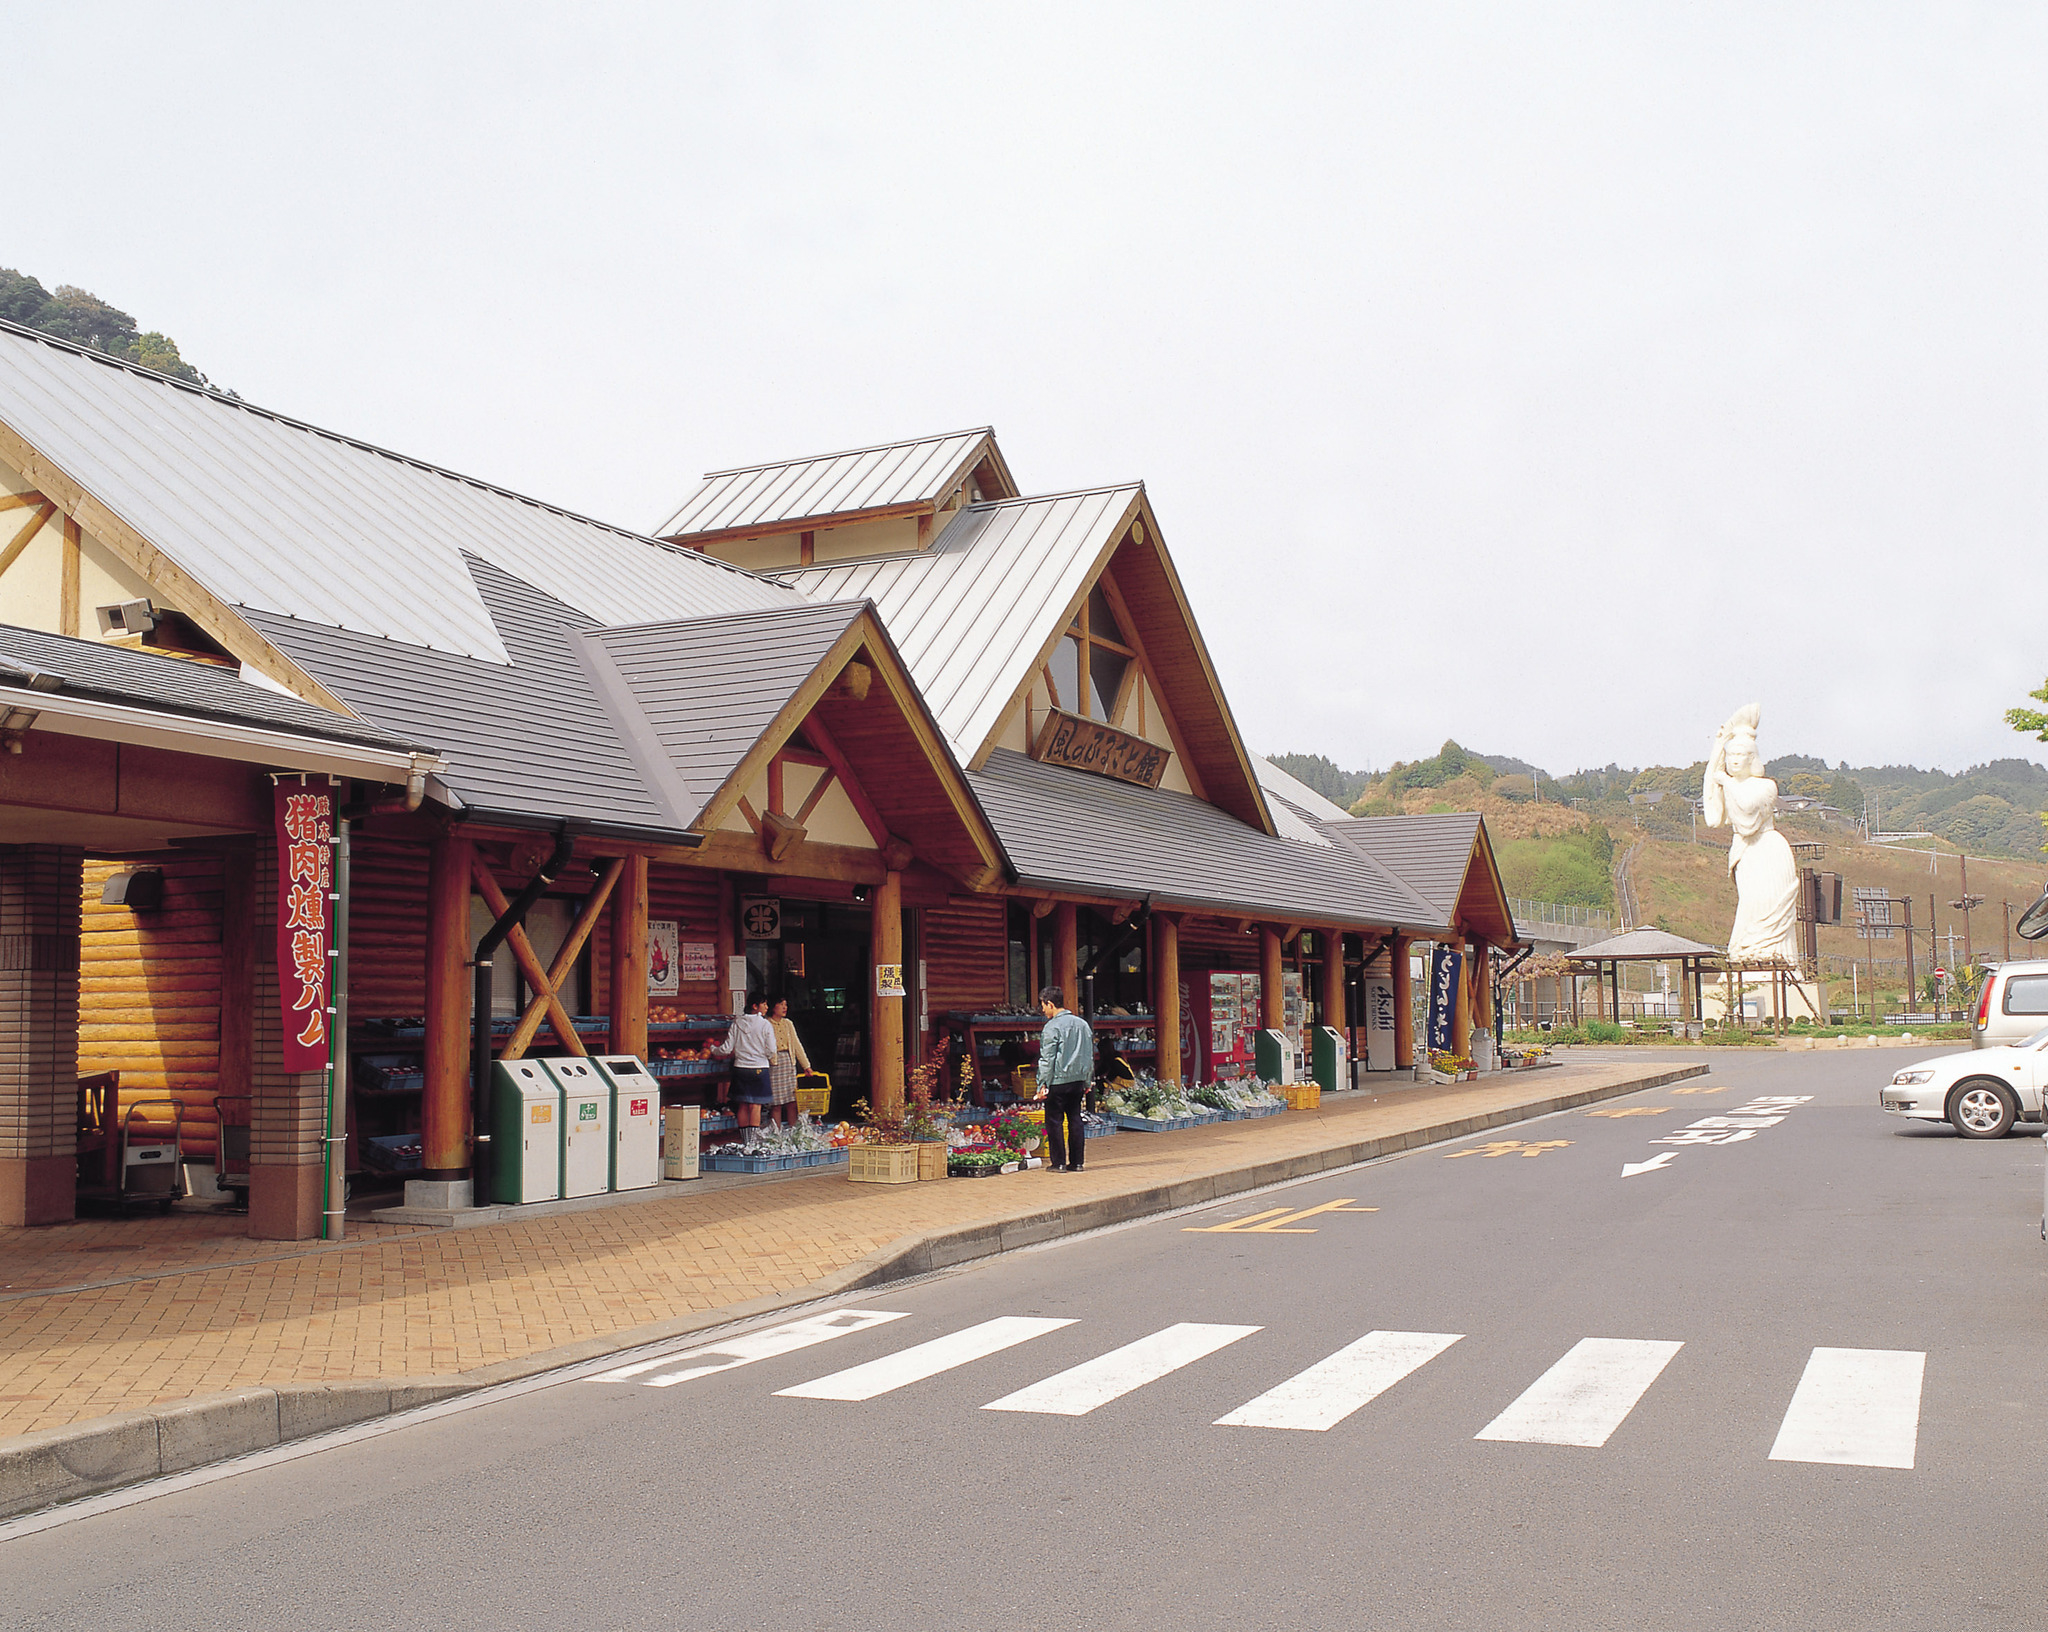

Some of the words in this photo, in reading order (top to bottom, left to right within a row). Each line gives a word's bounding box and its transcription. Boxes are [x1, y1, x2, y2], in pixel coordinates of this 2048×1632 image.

[1046, 718, 1161, 783] 風のふるさと館
[316, 795, 330, 888] 厳木特産
[285, 794, 326, 1048] 猪肉燻製ハム
[1369, 986, 1377, 1003] SOFT
[1377, 985, 1395, 1031] Asahi
